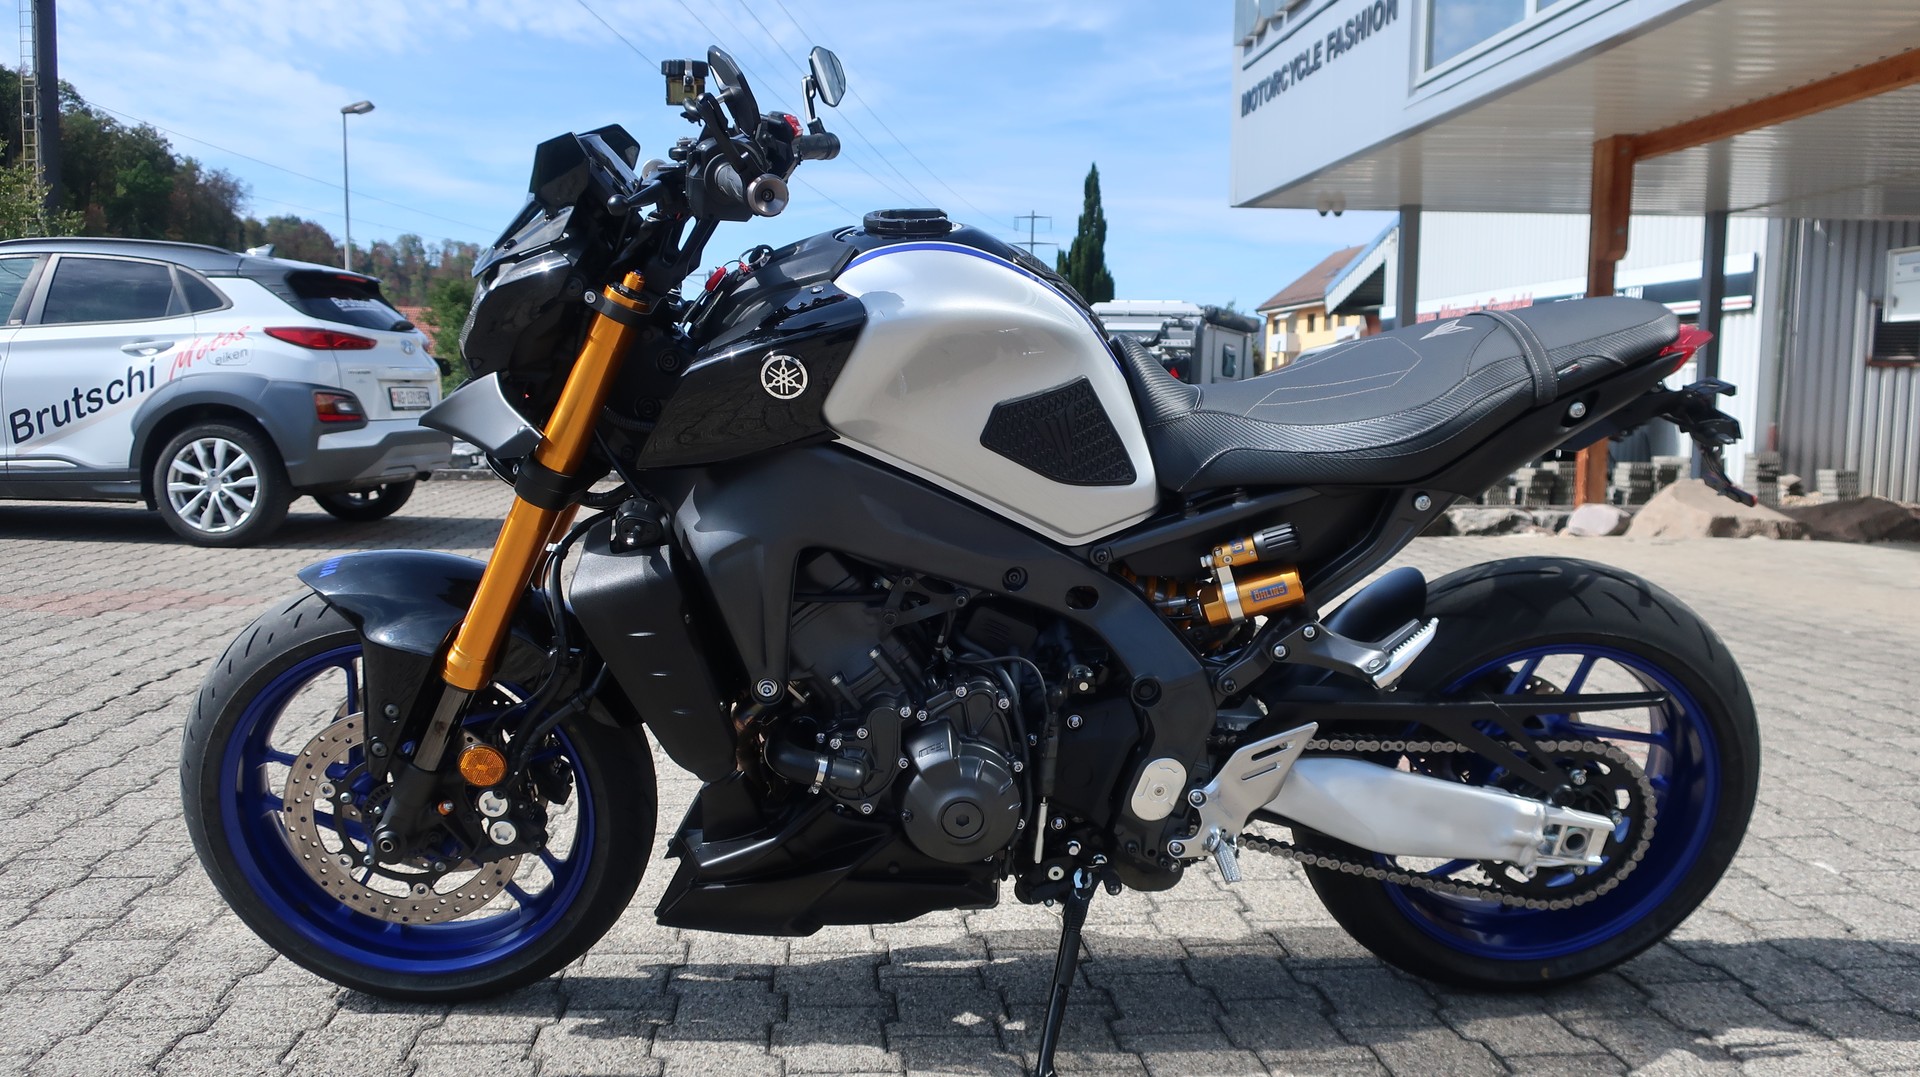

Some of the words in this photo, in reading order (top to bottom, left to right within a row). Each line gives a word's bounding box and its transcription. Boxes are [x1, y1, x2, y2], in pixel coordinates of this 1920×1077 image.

[1241, 40, 1323, 118] MOTORCYCLE
[1326, 0, 1398, 63] FASHION
[169, 325, 250, 382] Motos
[215, 349, 248, 366] eiken
[9, 357, 155, 444] Brutschi
